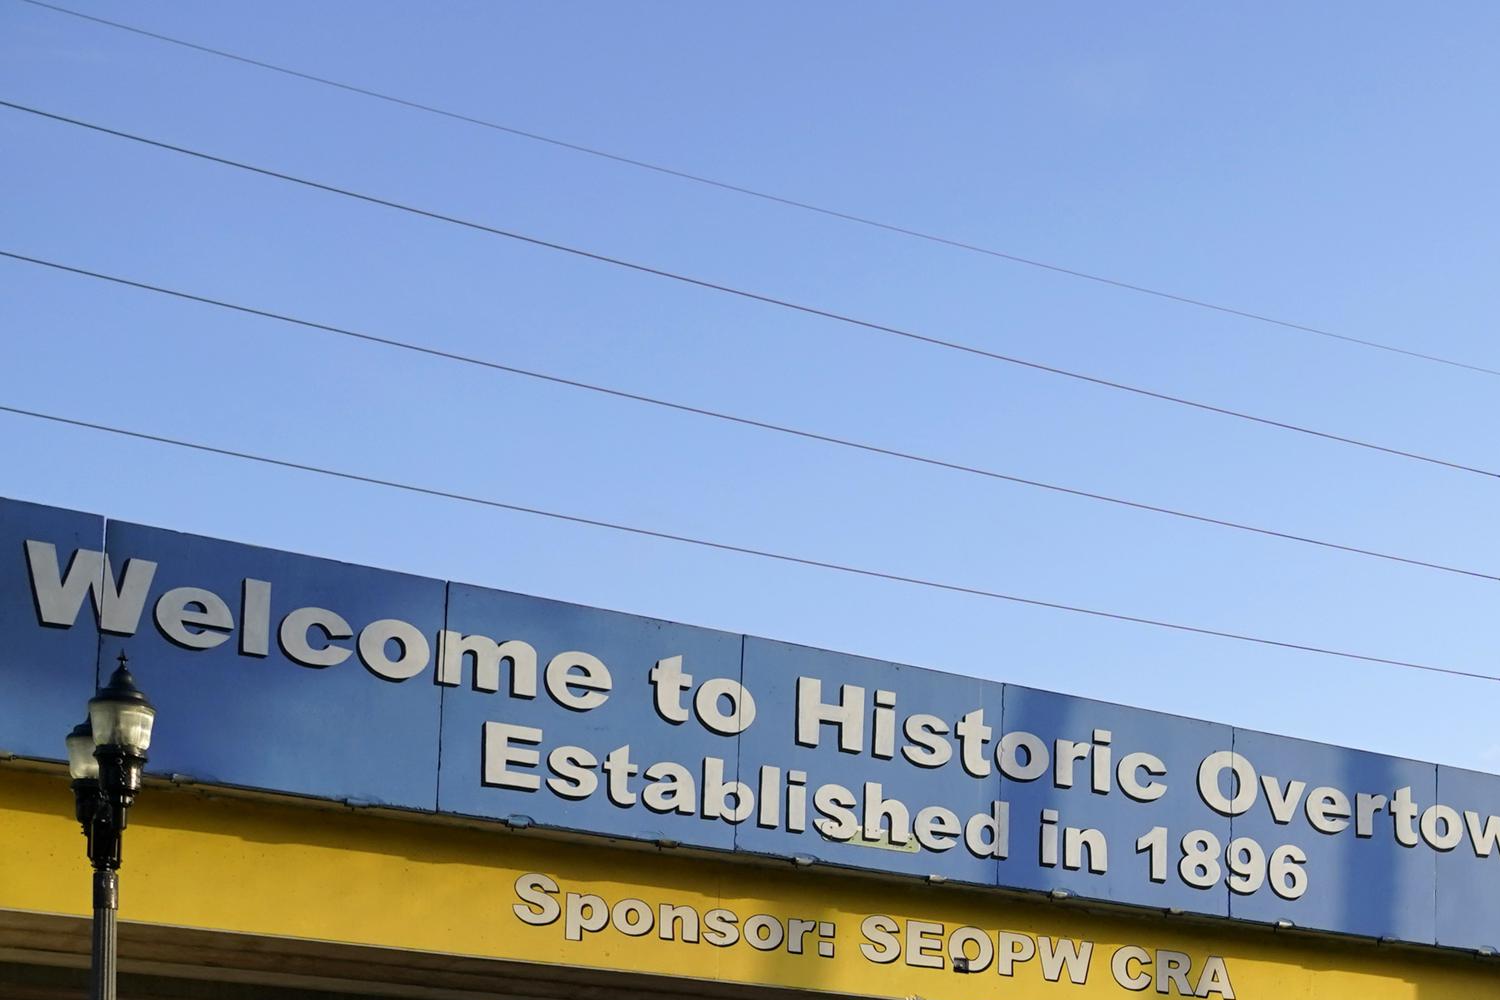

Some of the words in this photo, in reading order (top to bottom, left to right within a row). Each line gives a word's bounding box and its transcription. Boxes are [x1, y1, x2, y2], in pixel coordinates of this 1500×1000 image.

[26, 539, 615, 711] Welcome
[650, 653, 760, 736] to
[792, 675, 1169, 806] Historic
[483, 719, 1011, 862] Established
[1039, 808, 1110, 876] in
[1135, 825, 1309, 901] 1896
[512, 873, 837, 958] Sponsor:
[859, 914, 1094, 985] SEOPW
[1111, 945, 1237, 1000] CRA
